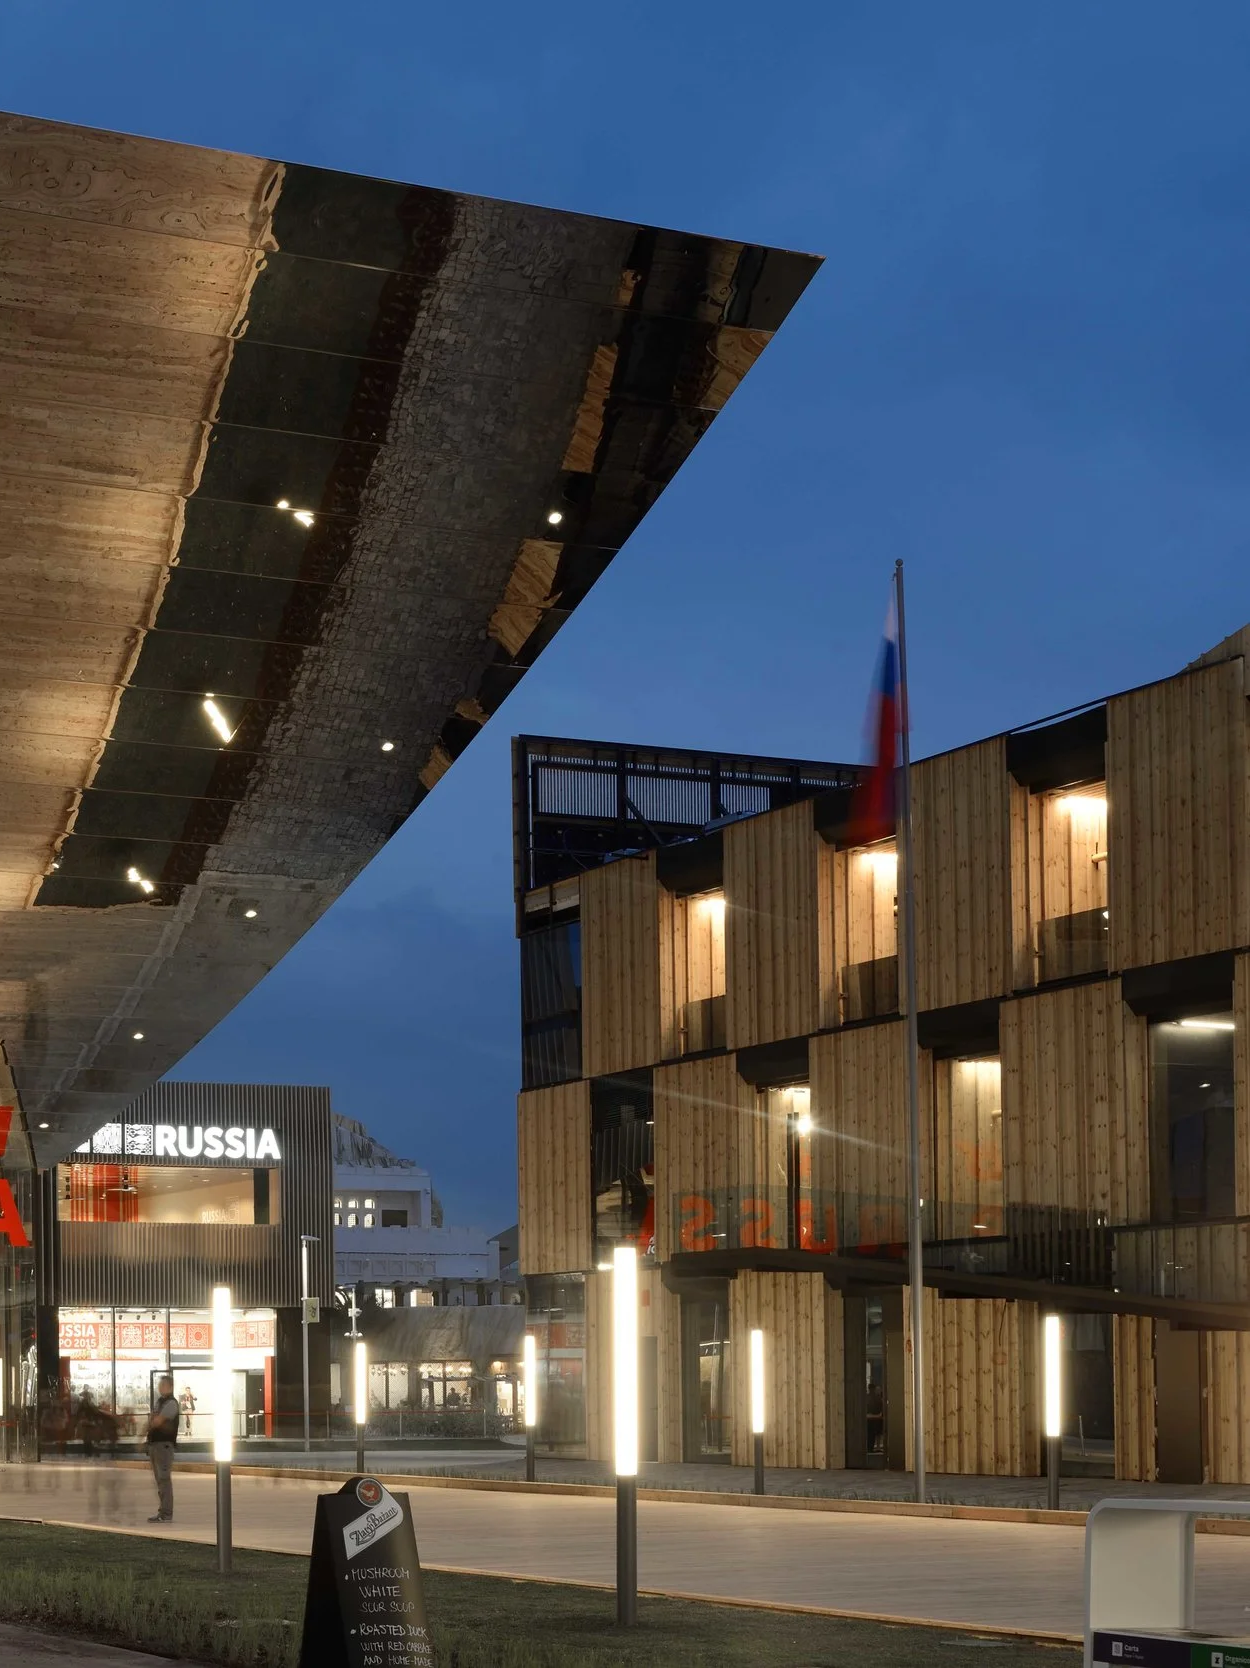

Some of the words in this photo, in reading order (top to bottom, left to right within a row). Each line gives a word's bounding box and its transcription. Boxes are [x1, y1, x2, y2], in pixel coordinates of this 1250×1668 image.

[155, 1125, 281, 1159] RUSSIA
[201, 1208, 227, 1223] RUSSIA
[74, 1338, 97, 1348] 2015
[351, 1567, 410, 1581] MUSHROOM
[358, 1585, 402, 1598] WHITE
[359, 1601, 387, 1613] SOUR
[389, 1601, 415, 1613] SOUP
[359, 1623, 406, 1637] ROASTED
[407, 1624, 429, 1640] DUCK
[360, 1641, 384, 1652] WITH
[387, 1641, 405, 1652] RED
[363, 1655, 383, 1666] AND
[388, 1653, 434, 1667] HOME-MADE
